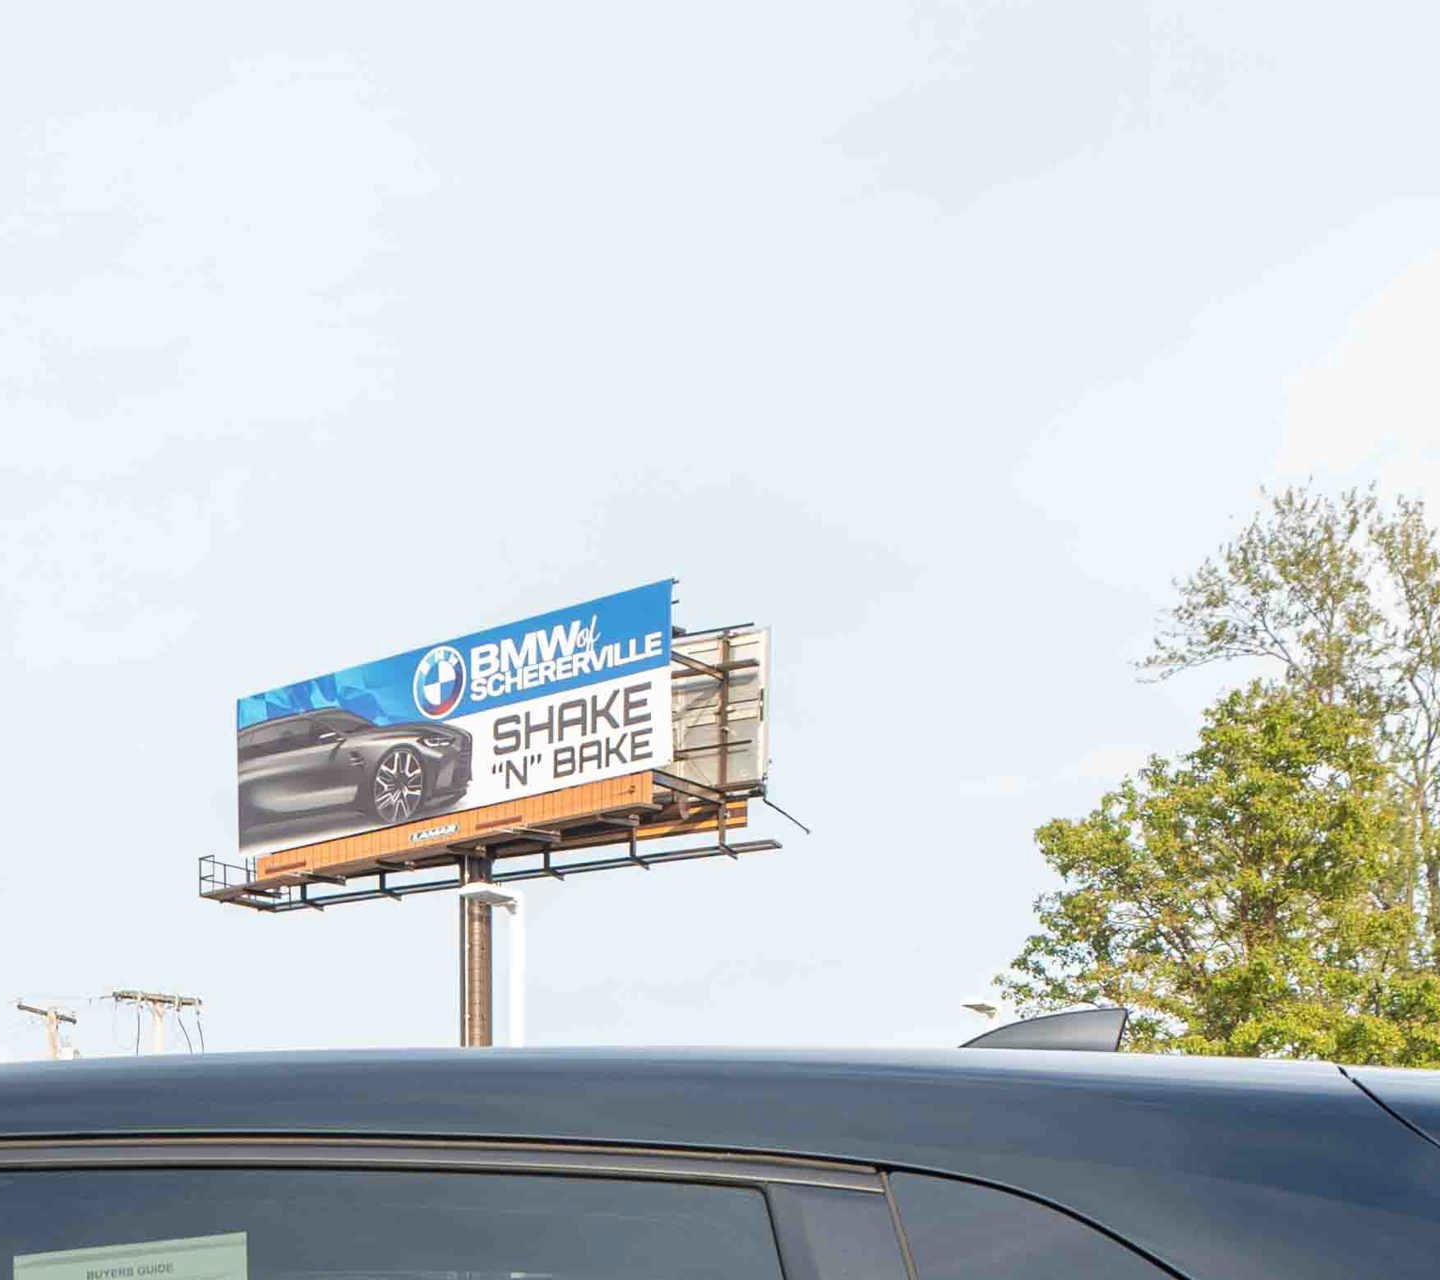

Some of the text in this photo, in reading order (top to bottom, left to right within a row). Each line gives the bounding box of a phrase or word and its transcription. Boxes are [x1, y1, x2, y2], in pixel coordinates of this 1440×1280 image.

[470, 614, 601, 677] BMW of
[471, 631, 663, 700] SCHERERVILLE
[493, 681, 652, 755] SHAKE
[553, 727, 653, 778] BAKE
[137, 1263, 174, 1276] GUIDE
